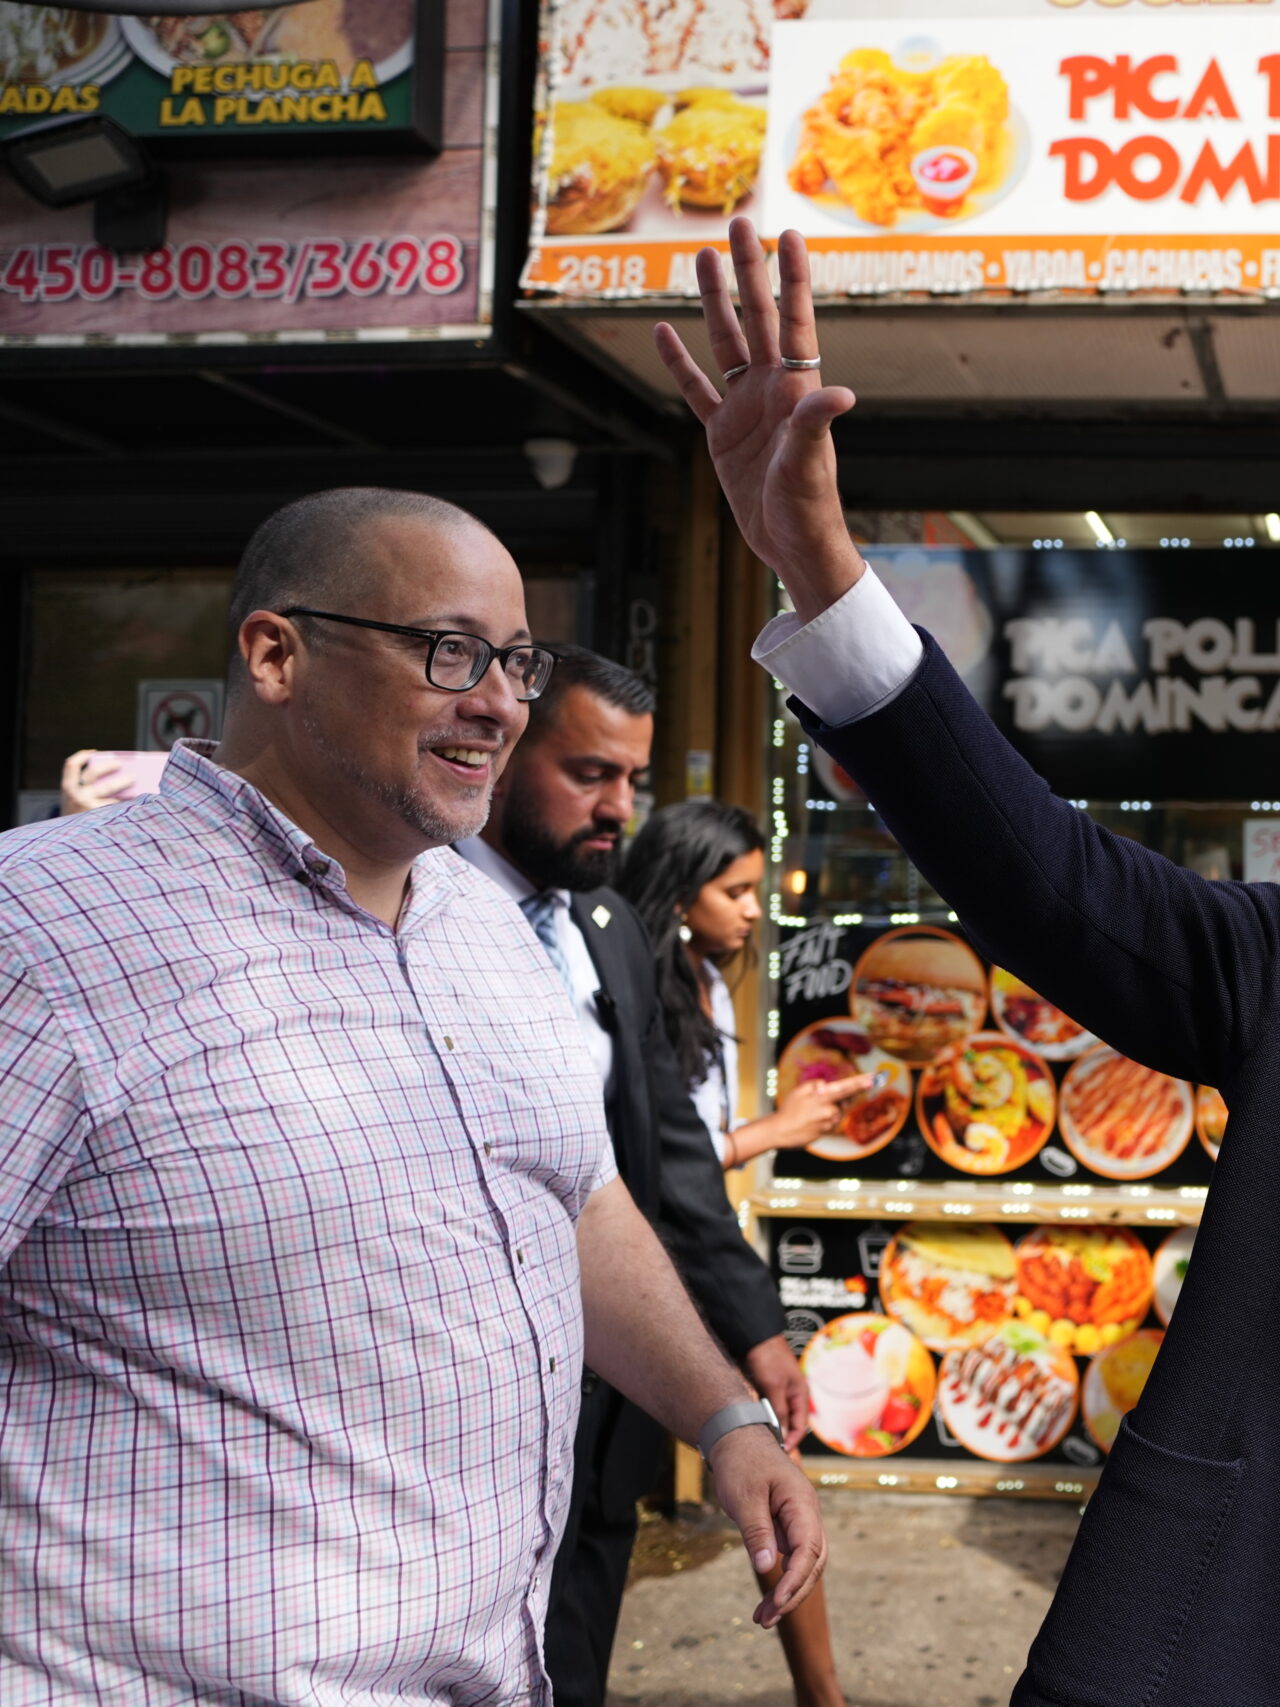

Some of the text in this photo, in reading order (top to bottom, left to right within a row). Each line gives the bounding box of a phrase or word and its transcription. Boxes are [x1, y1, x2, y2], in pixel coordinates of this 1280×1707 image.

[170, 60, 378, 94] PECHUGA A
[1059, 54, 1240, 120] PICA
[159, 92, 387, 127] LA PLANCHA
[1, 236, 463, 301] 450-8083/3698
[558, 254, 647, 290] 2618
[1003, 249, 1087, 287] YAROA
[1104, 248, 1243, 287] CACHAPAS
[1004, 617, 1137, 673] PICA
